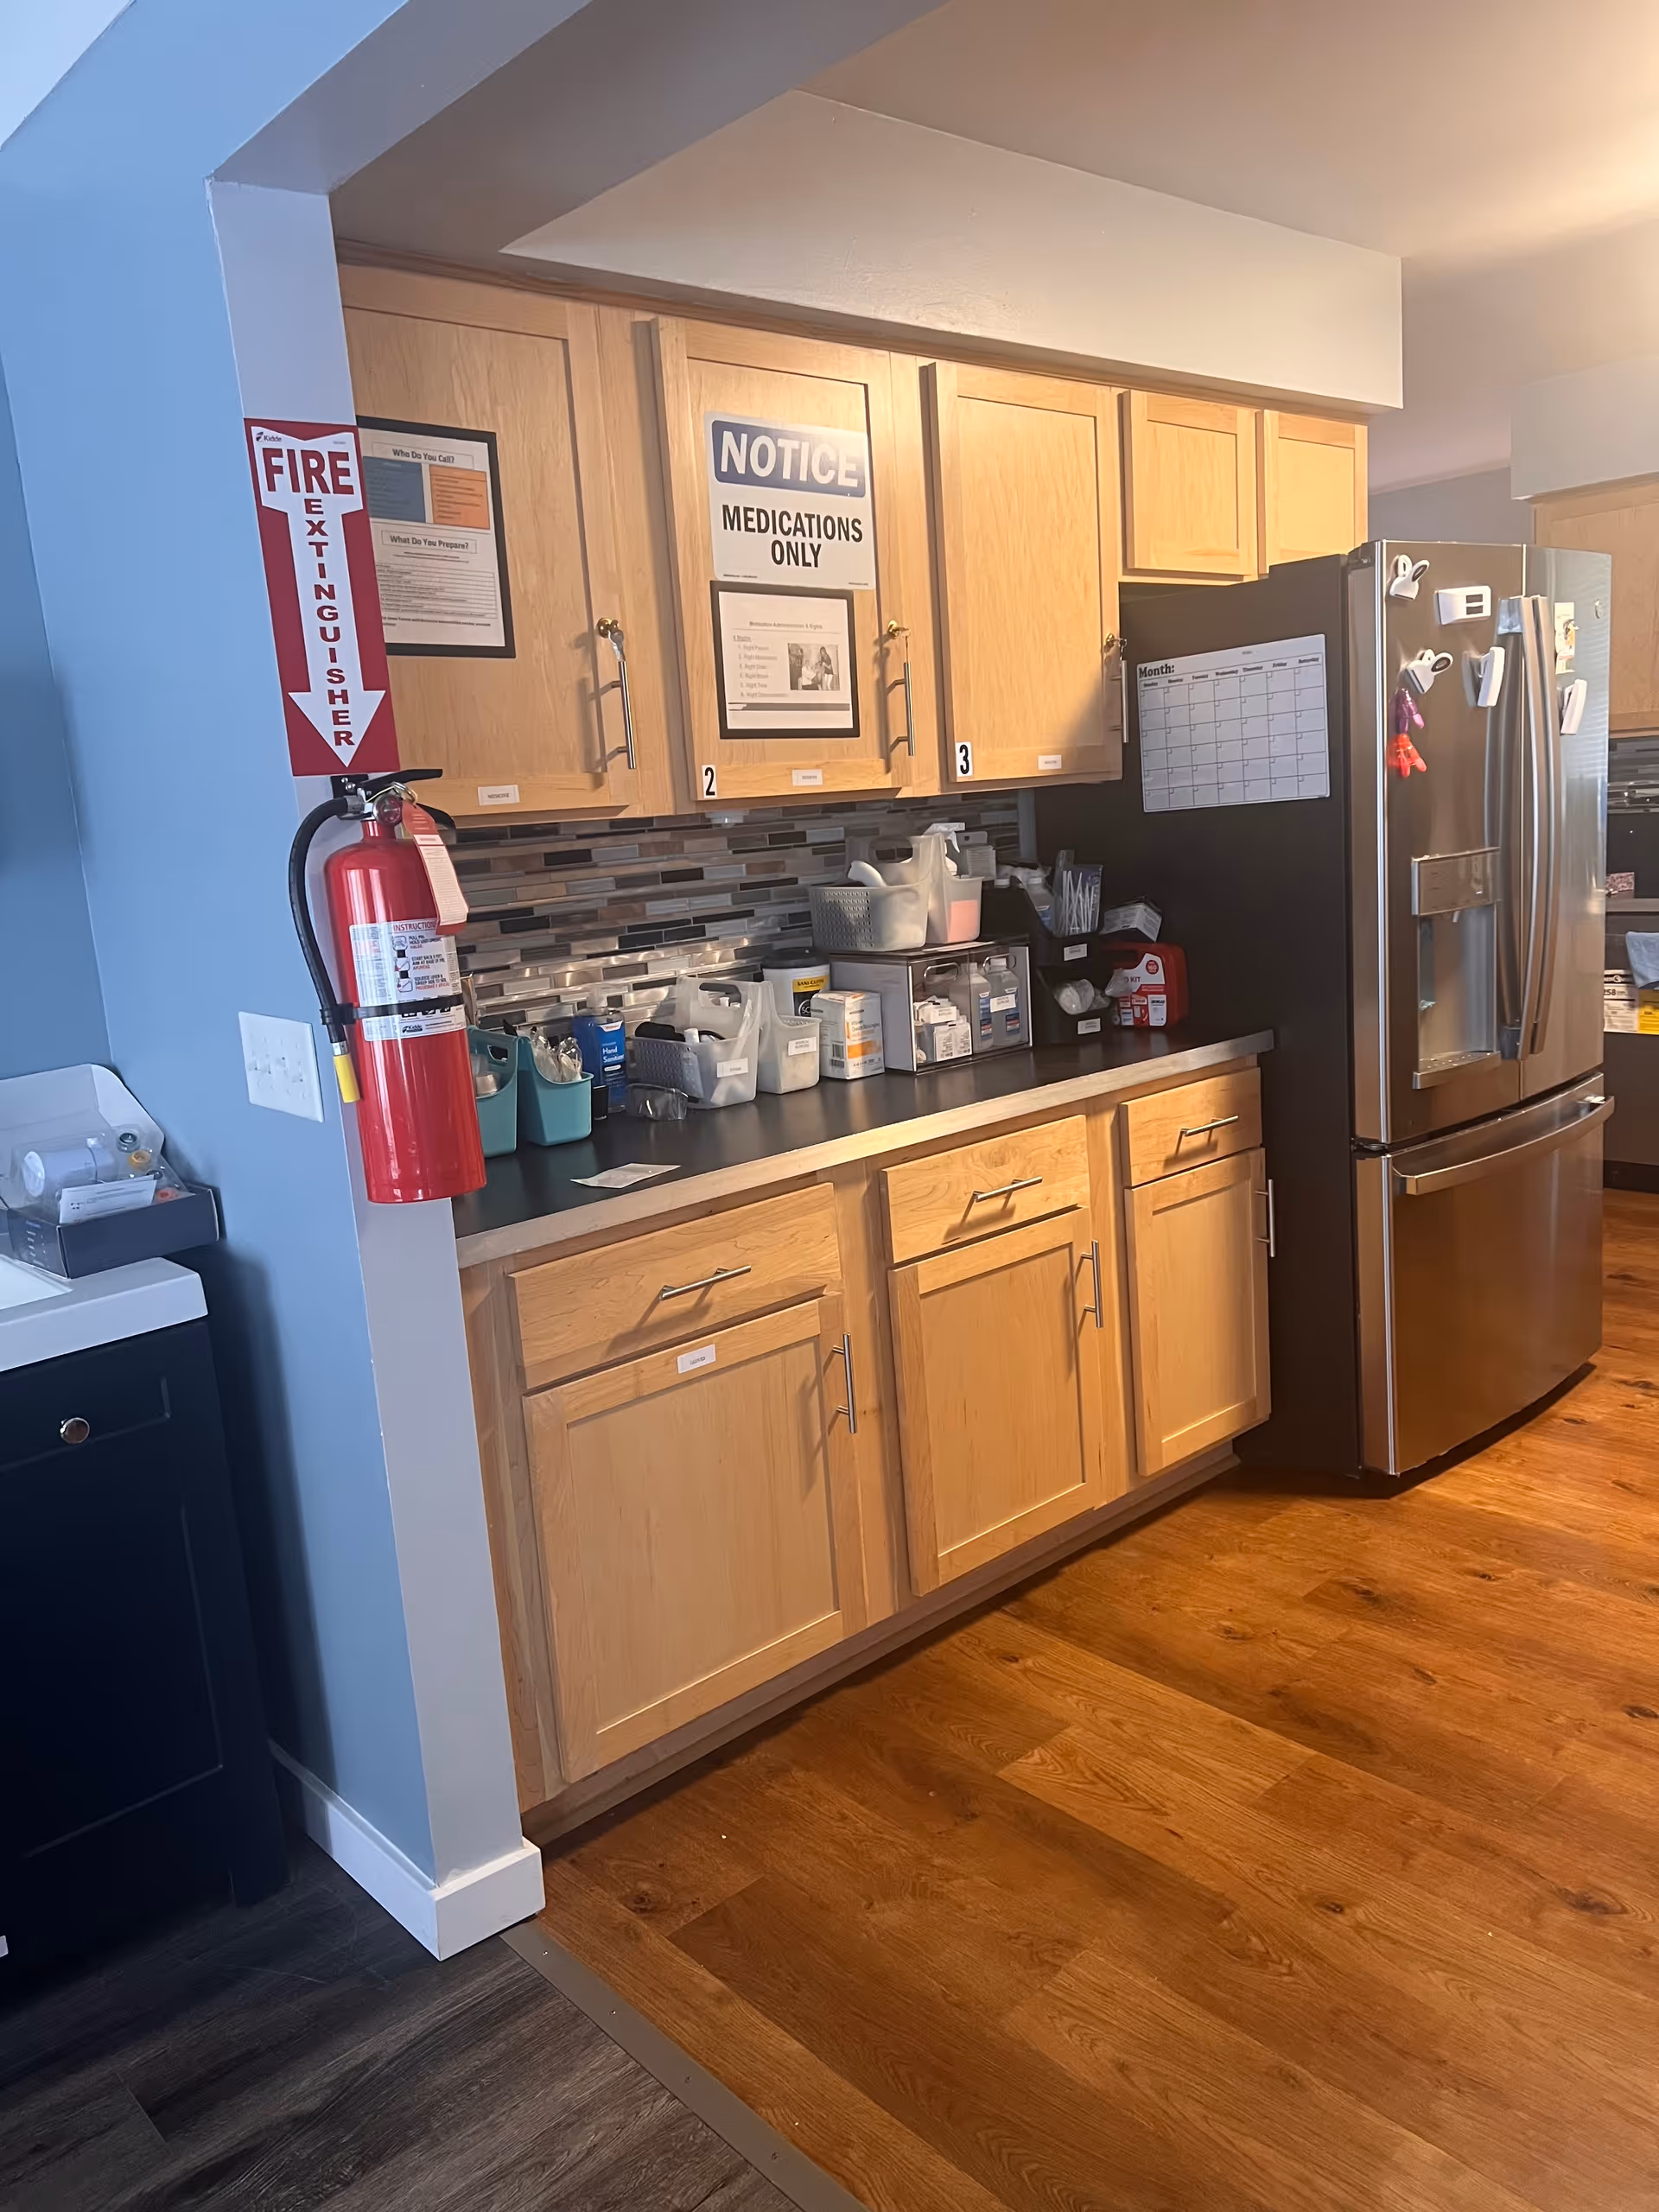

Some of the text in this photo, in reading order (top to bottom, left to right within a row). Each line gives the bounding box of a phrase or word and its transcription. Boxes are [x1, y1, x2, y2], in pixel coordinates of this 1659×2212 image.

[264, 434, 282, 442] Kidde
[262, 447, 355, 495] FIRE
[392, 448, 455, 464] Who Do You Call?
[721, 430, 859, 487] NOTICE
[722, 504, 863, 543] MEDICATIONS
[390, 535, 469, 550] What Do You Prepare?
[770, 539, 822, 569] ONLY
[305, 499, 355, 747] EXTINGUISHER
[1138, 664, 1175, 678] Month:
[959, 744, 969, 775] 3
[704, 766, 715, 796] 2
[602, 1046, 618, 1055] Hand
